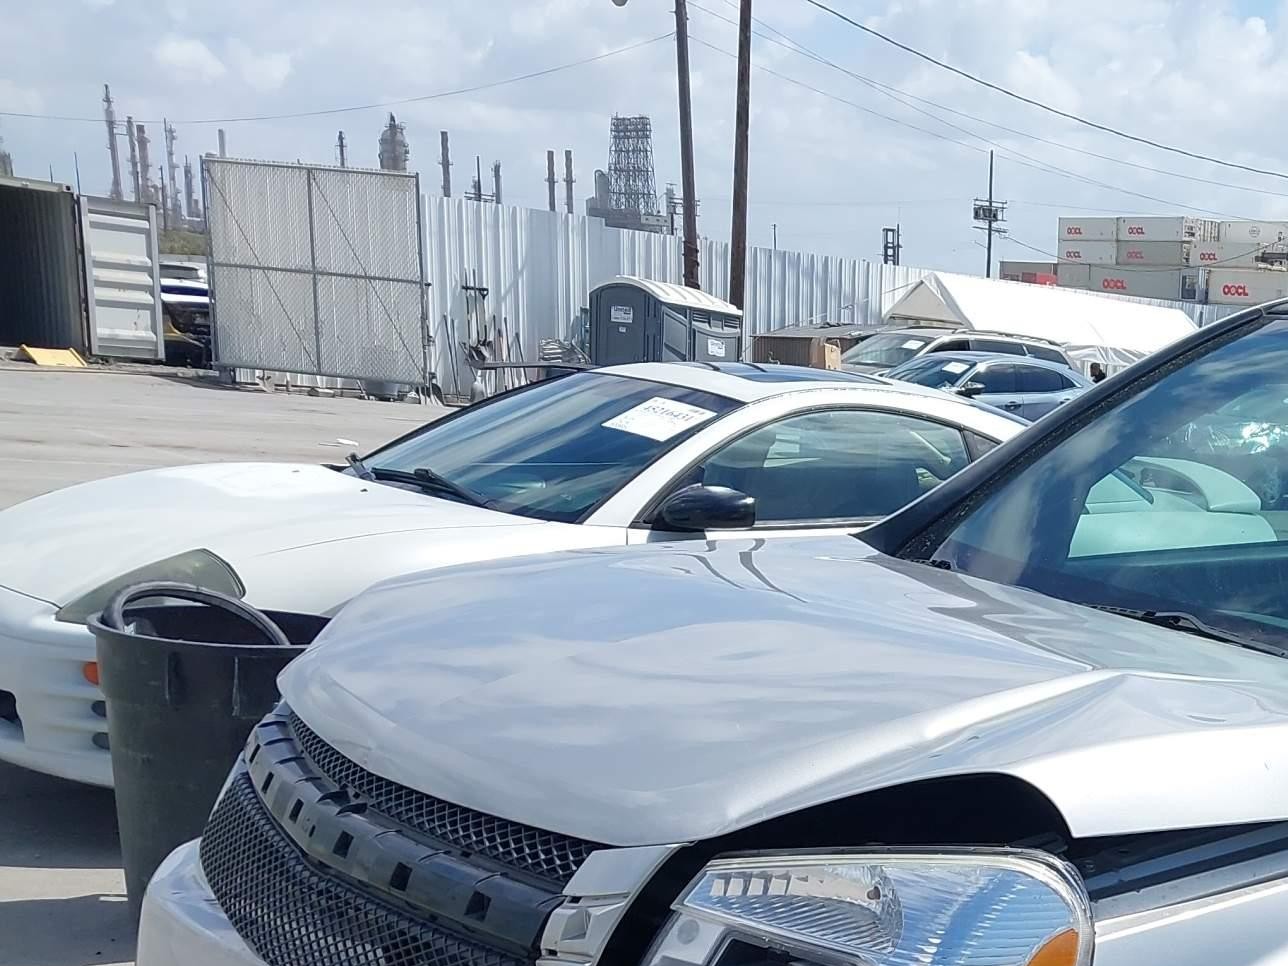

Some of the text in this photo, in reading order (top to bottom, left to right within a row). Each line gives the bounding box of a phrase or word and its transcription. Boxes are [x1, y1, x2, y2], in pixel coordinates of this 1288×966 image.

[1128, 226, 1145, 235] OOCL
[1200, 252, 1218, 261] OOCL
[1102, 278, 1127, 290] OOCL
[1222, 284, 1249, 297] OOCL
